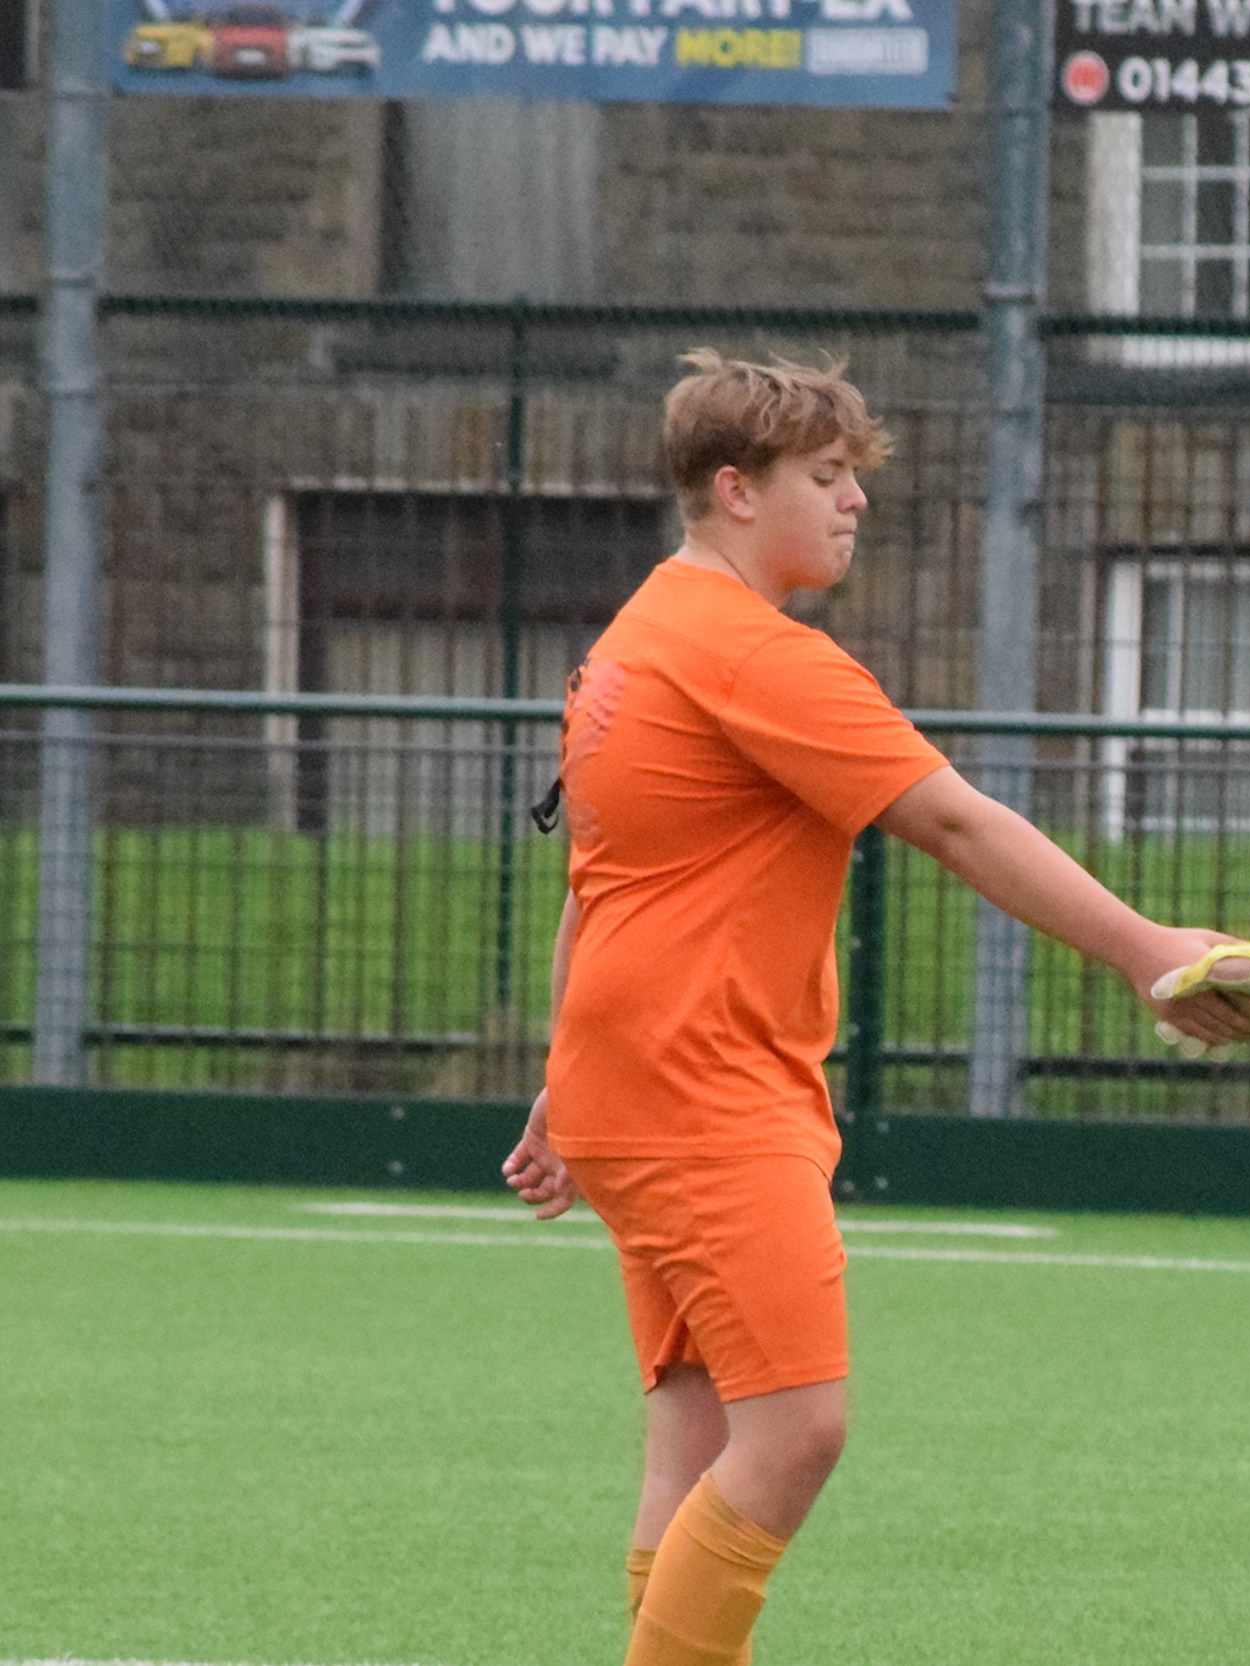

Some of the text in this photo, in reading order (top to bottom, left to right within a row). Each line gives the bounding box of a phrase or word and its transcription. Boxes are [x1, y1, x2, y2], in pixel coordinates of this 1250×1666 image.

[1072, 0, 1197, 36] TEAM
[423, 22, 517, 65] AND
[519, 24, 588, 66] WE
[591, 25, 669, 66] PAY
